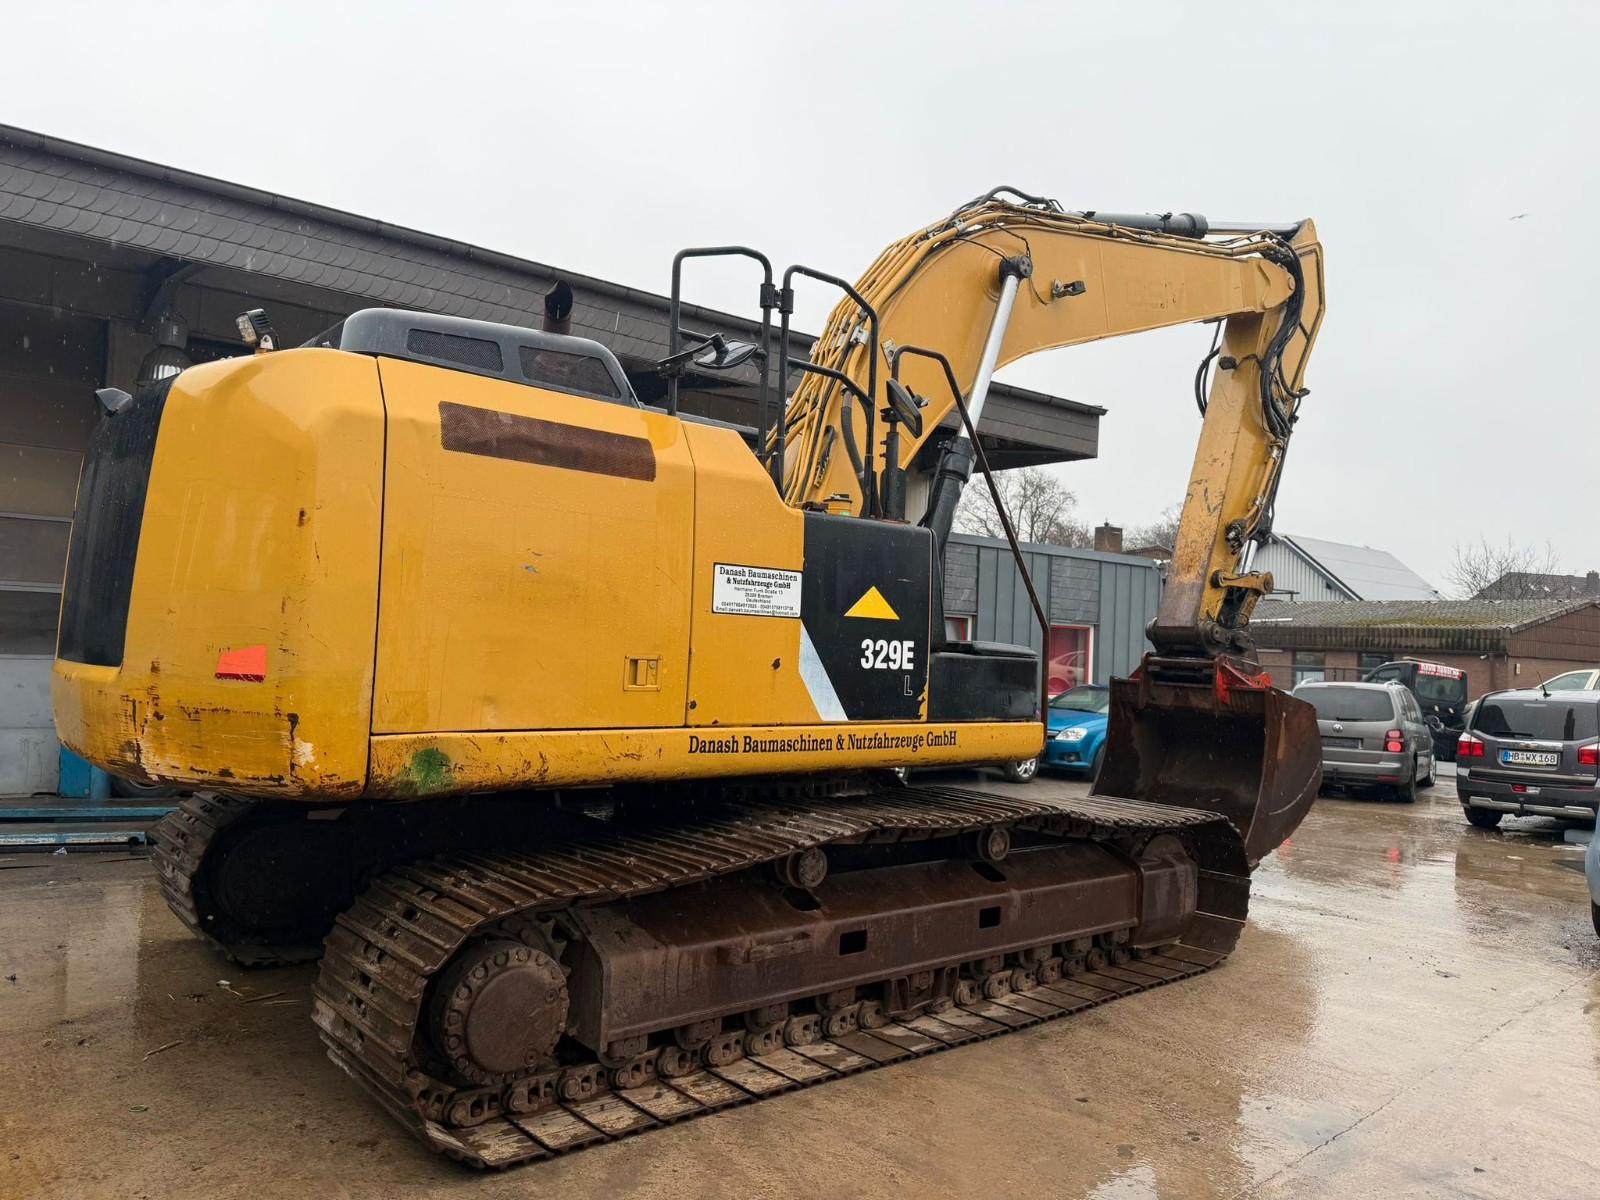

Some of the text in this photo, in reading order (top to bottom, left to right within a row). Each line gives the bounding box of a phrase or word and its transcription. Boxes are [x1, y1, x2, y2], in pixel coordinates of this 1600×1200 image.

[719, 567, 798, 582] Danash Baumaschinen
[732, 578, 773, 589] Nutzfahrzeuge
[774, 581, 791, 589] GmbH
[860, 638, 915, 670] 329E
[904, 674, 913, 696] L
[688, 731, 957, 754] Danash Baumaschinen & Nutzfahrzeuge GmbH
[1508, 752, 1520, 761] HB
[1525, 753, 1537, 762] WX
[1539, 754, 1556, 763] 168
